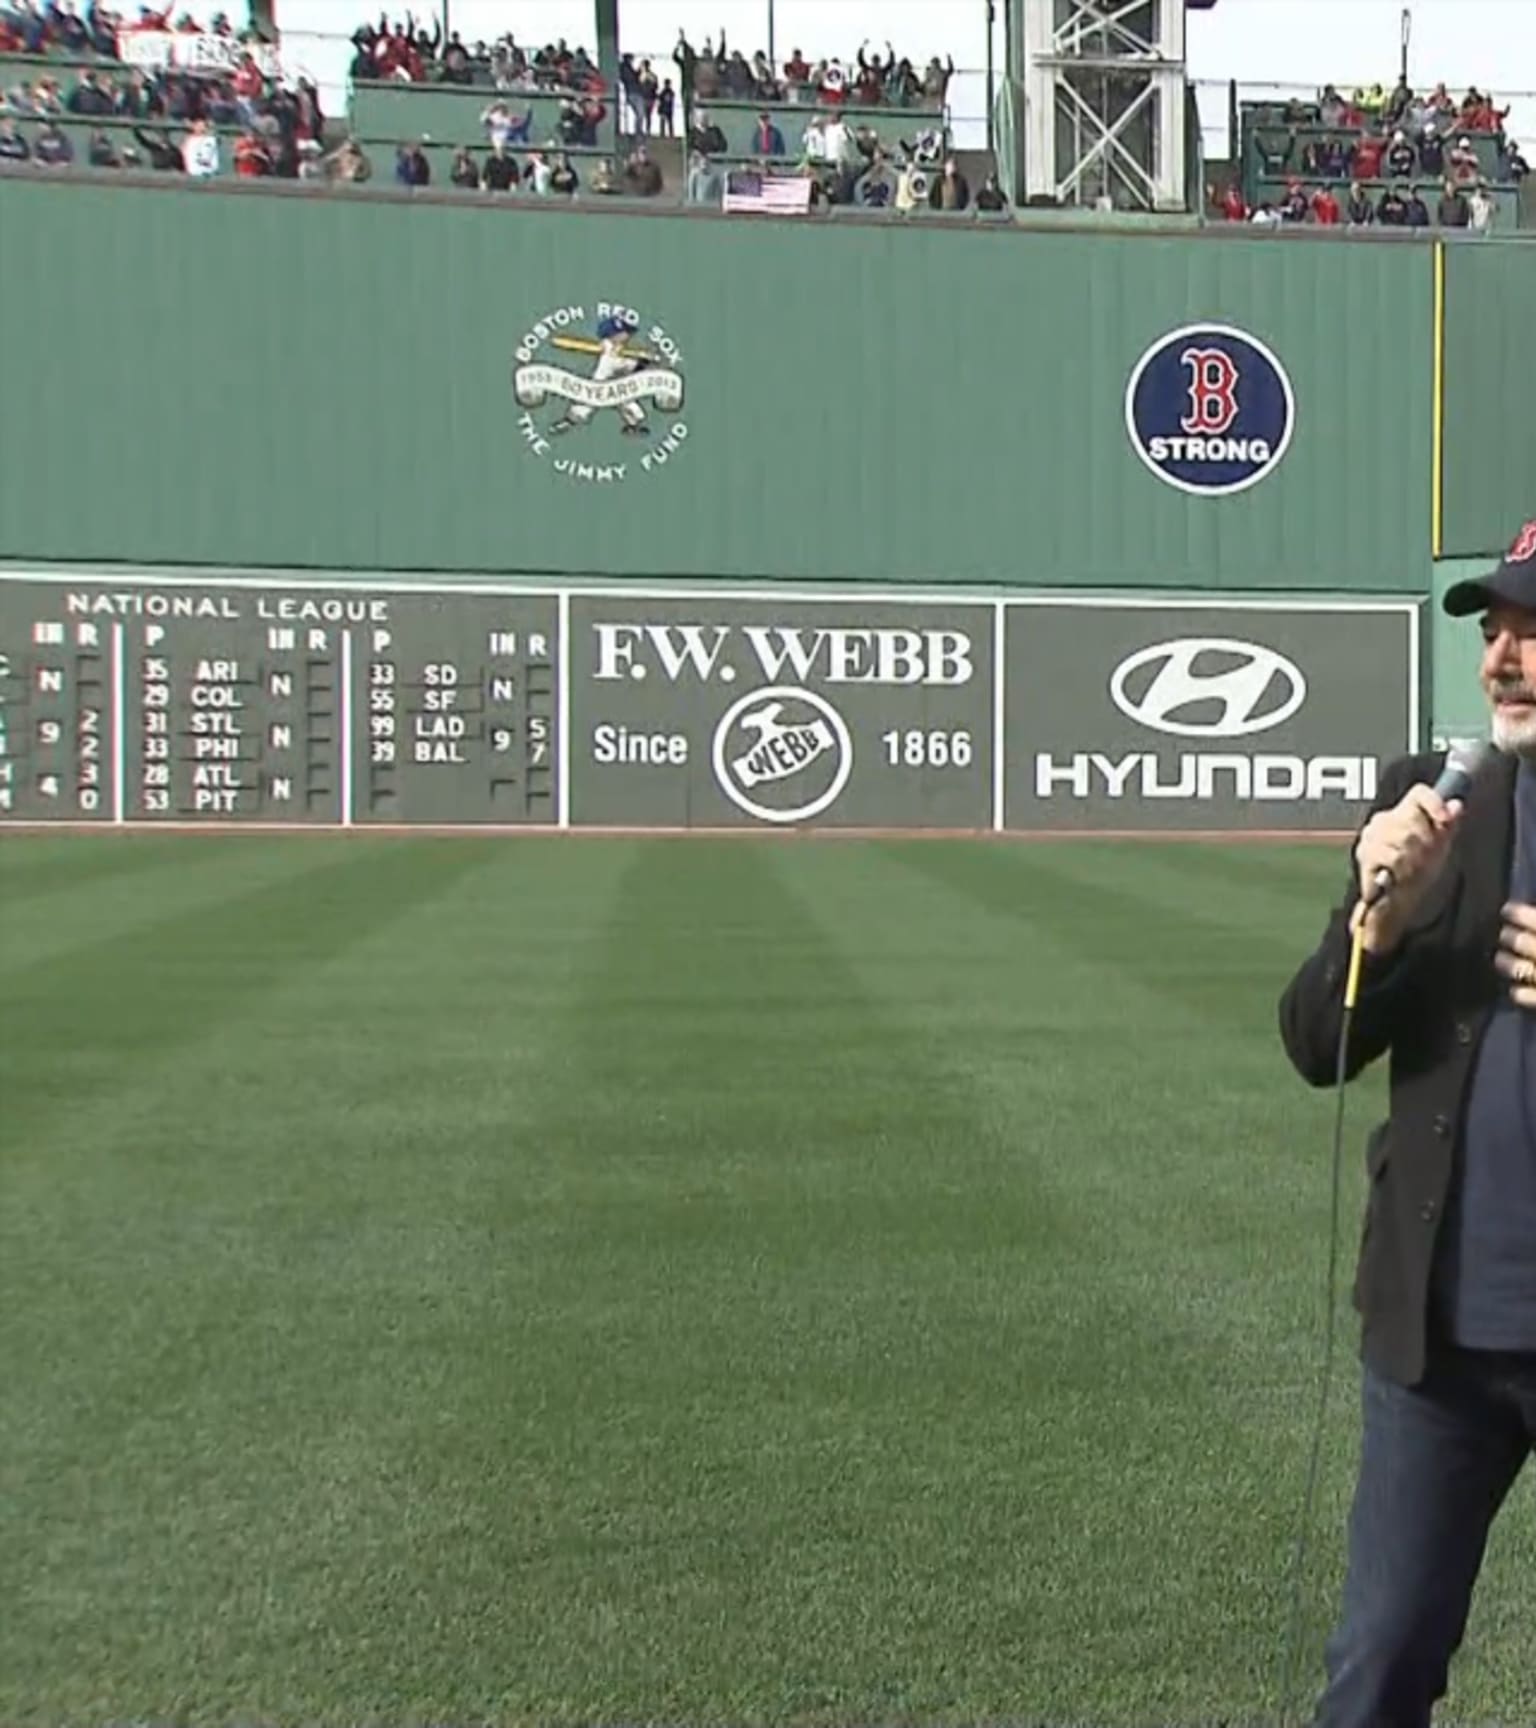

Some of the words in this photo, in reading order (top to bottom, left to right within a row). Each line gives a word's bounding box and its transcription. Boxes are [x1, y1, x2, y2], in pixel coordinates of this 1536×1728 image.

[515, 306, 584, 362] BOSTON
[597, 302, 639, 325] RED
[649, 326, 682, 365] SOX
[584, 380, 639, 400] YEARS
[1181, 347, 1239, 434] B
[517, 412, 549, 455] THE
[554, 459, 626, 481] JIMMY
[640, 423, 687, 470] FUND
[1150, 436, 1270, 462] STRONG
[68, 593, 240, 617] NATIONAL
[257, 597, 388, 621] LEAGUE
[78, 622, 99, 646] R
[144, 625, 165, 647] P
[308, 628, 327, 650] R
[373, 630, 392, 653] P
[528, 634, 547, 656] R
[742, 625, 974, 686] WEBB
[39, 669, 63, 692] N
[196, 660, 238, 681] ARI
[370, 663, 394, 685] 33
[424, 663, 458, 686] SD
[190, 685, 243, 707] COL
[270, 673, 292, 696] N
[492, 678, 513, 700] N
[370, 689, 394, 711] 55
[424, 689, 457, 711] SF
[39, 721, 60, 743] 9
[80, 709, 98, 732] 2
[145, 711, 167, 733] 31
[190, 712, 241, 735] STL
[370, 715, 395, 736] 99
[415, 715, 465, 737] LAD
[529, 718, 546, 739] 5
[80, 736, 99, 757] 2
[145, 737, 169, 758] 33
[195, 738, 239, 758] PHI
[272, 724, 291, 748] N
[493, 730, 511, 751] 9
[593, 725, 689, 764] Since
[372, 741, 396, 762] 39
[414, 741, 466, 762] BAL
[531, 742, 546, 764] 7
[747, 726, 821, 776] WEBB
[882, 730, 972, 766] 1866
[80, 761, 98, 784] 3
[143, 765, 169, 786] 28
[193, 764, 241, 786] ATL
[1036, 752, 1377, 800] HYUNDAI
[39, 775, 59, 797] 4
[272, 777, 291, 800] N
[79, 788, 99, 810] 0
[144, 789, 169, 810] 53
[195, 789, 238, 812] PIT
